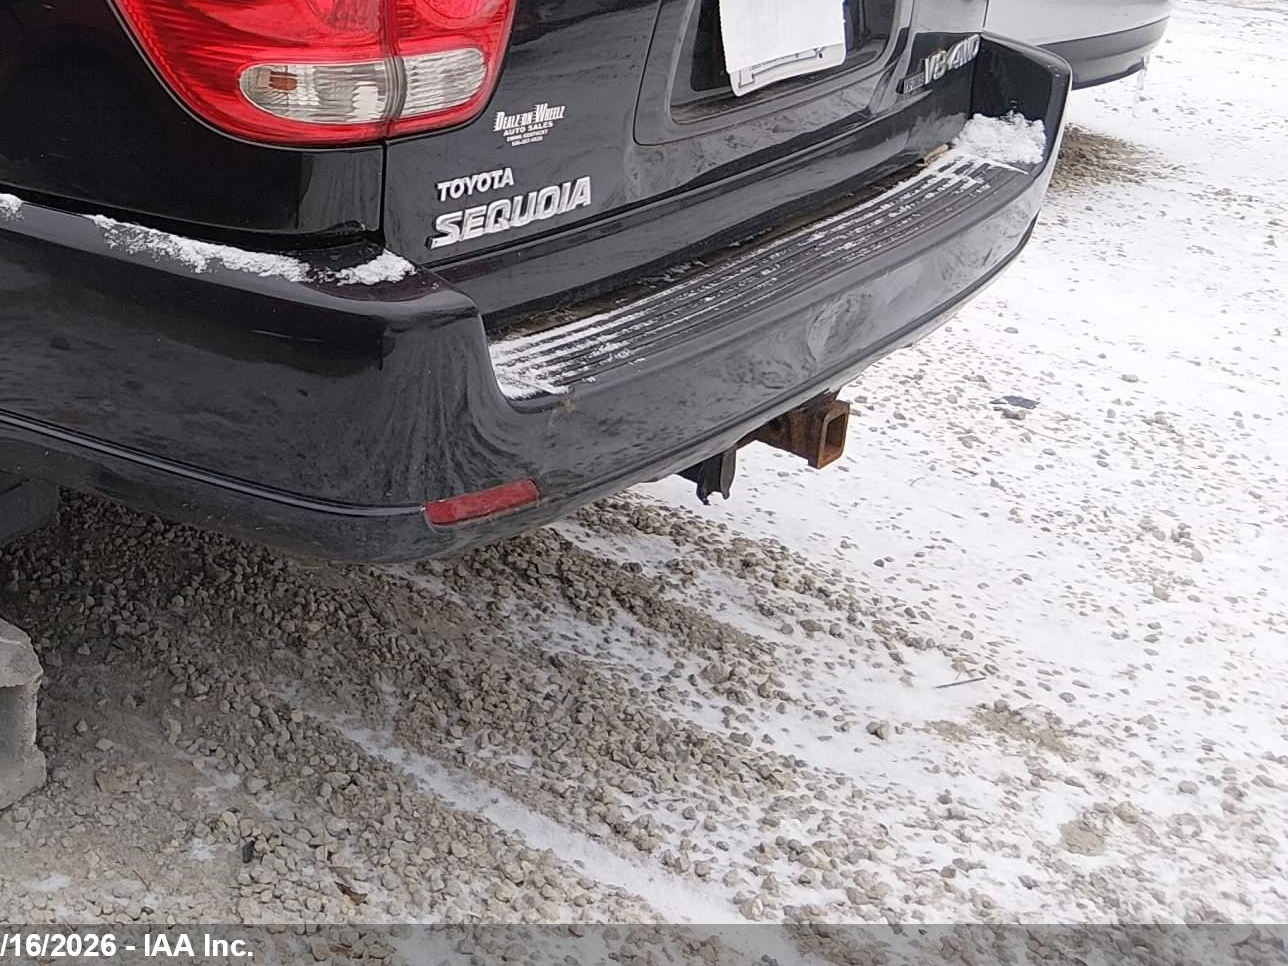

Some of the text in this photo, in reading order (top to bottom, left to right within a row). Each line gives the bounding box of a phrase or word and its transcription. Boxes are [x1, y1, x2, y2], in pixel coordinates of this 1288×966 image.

[503, 121, 554, 137] AUTO SALES
[437, 167, 514, 202] TOYOTA
[429, 176, 591, 249] SEQUOIA
